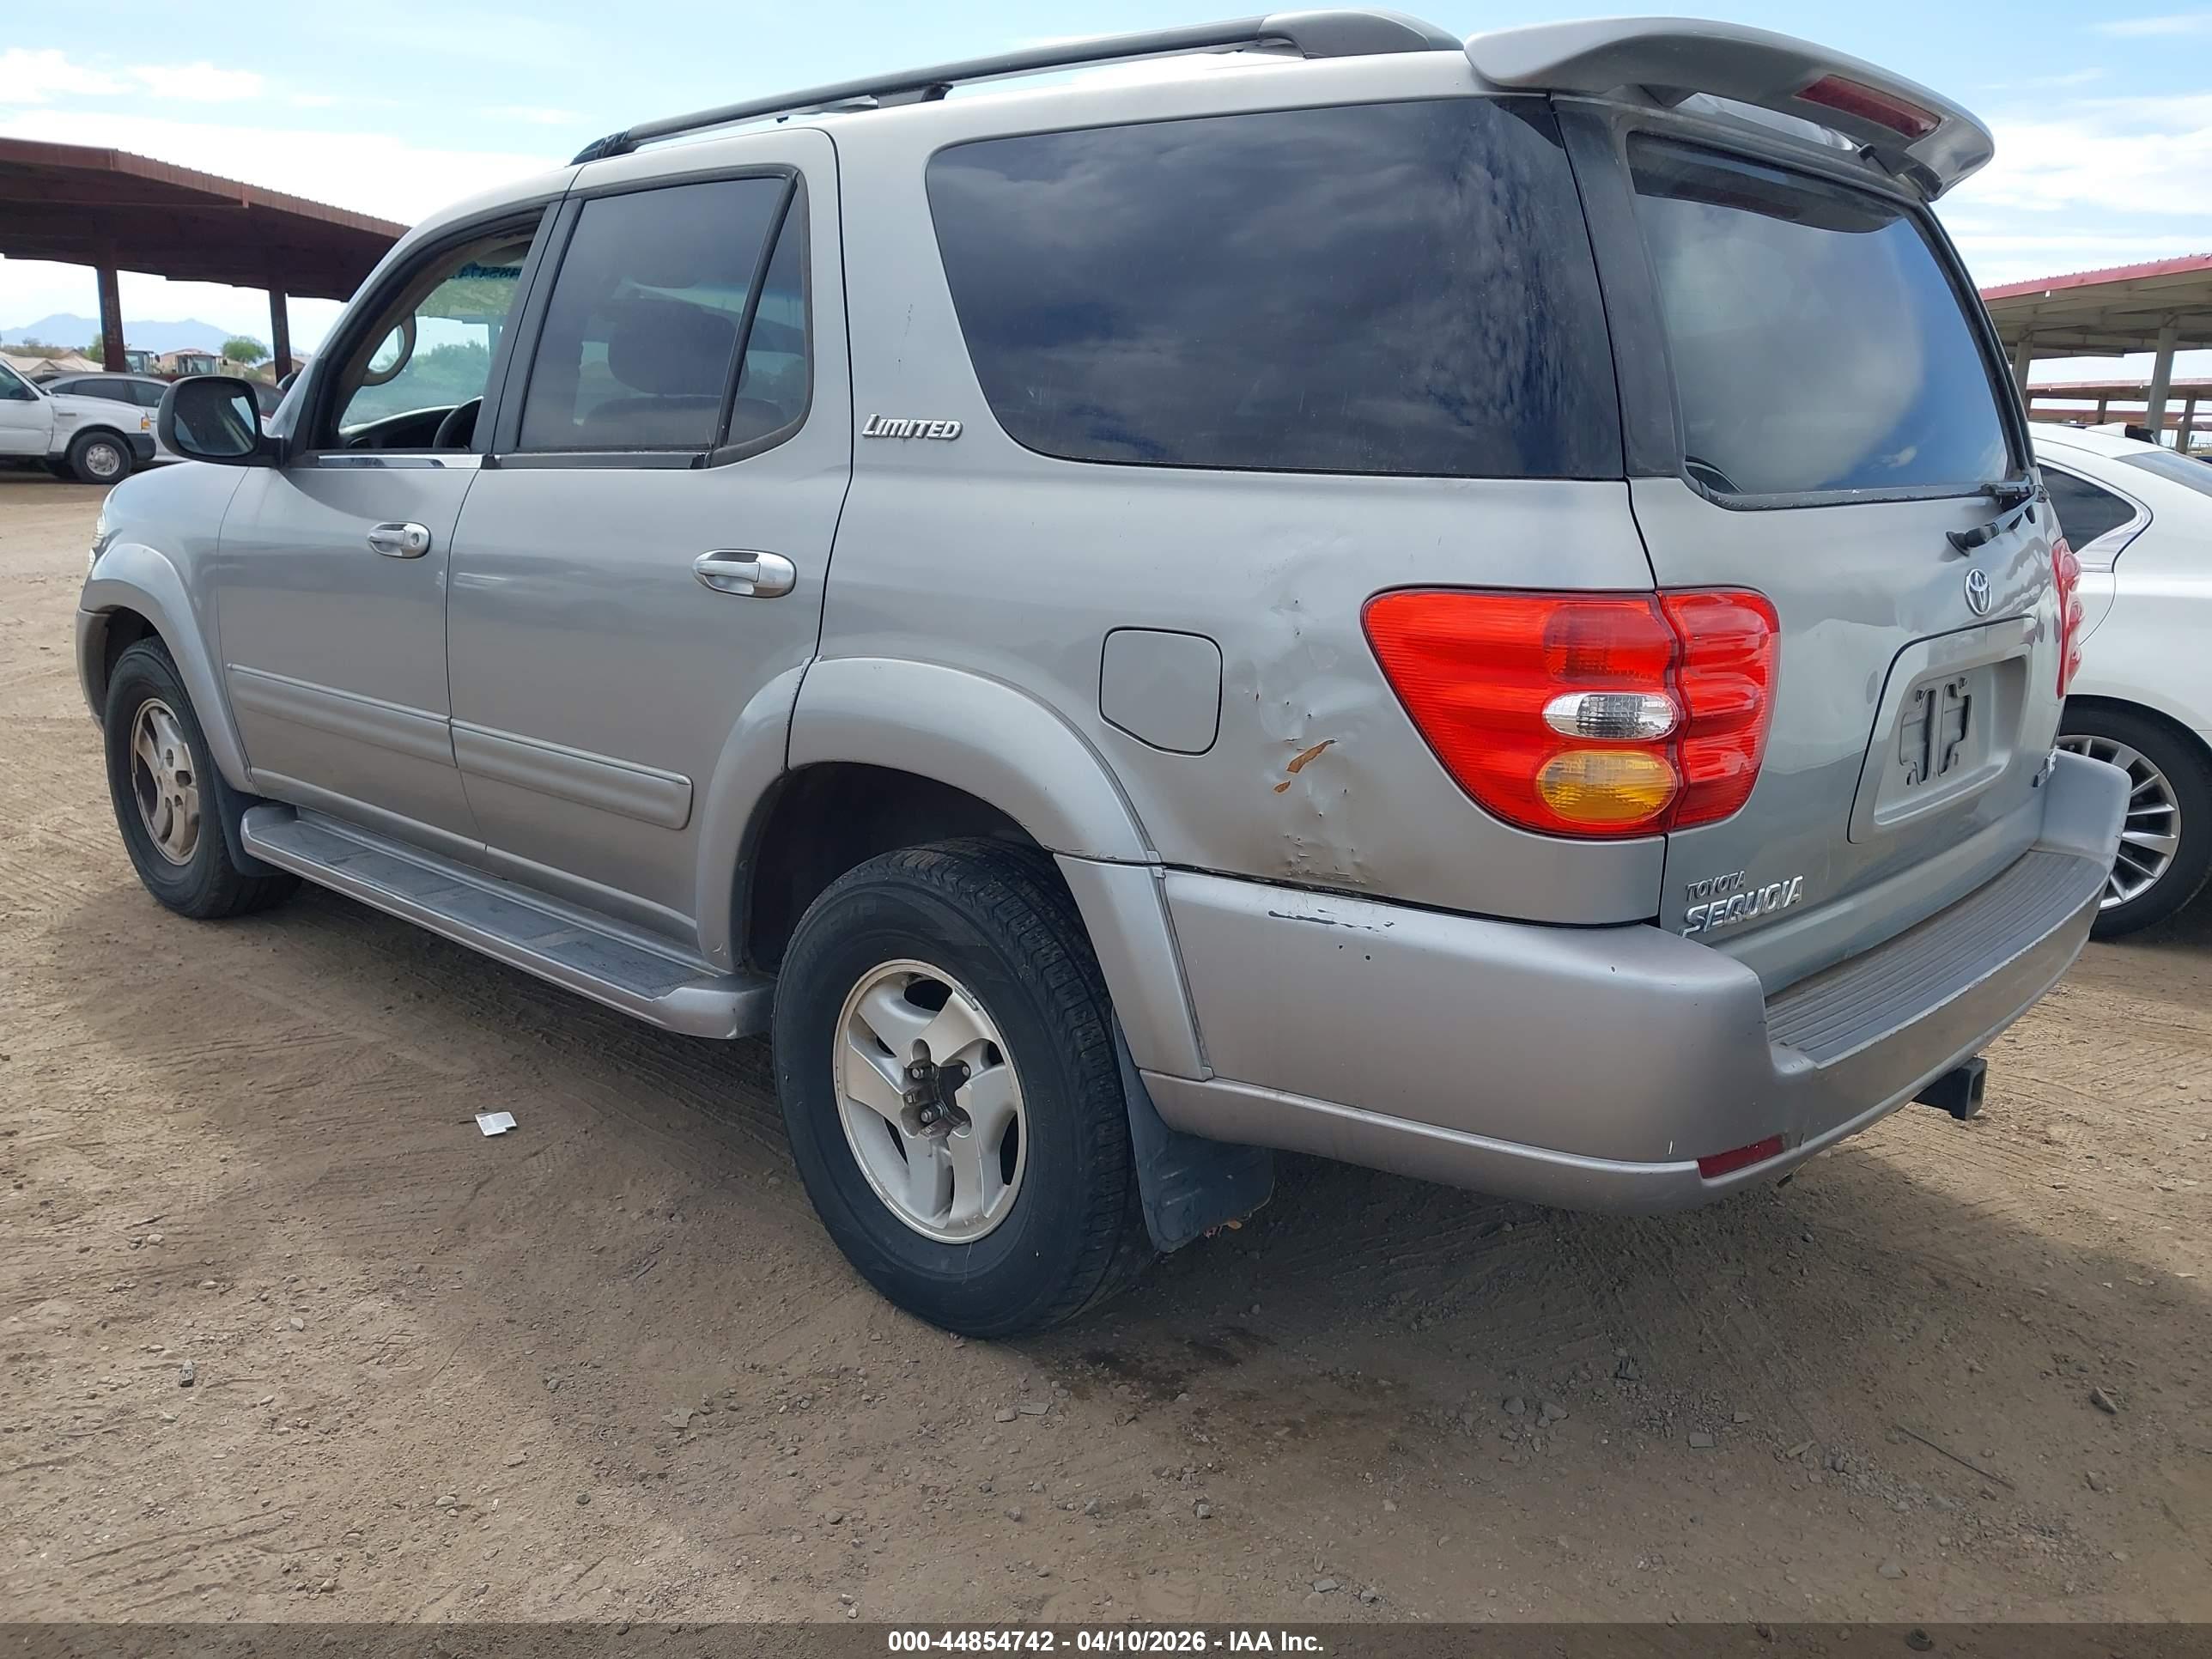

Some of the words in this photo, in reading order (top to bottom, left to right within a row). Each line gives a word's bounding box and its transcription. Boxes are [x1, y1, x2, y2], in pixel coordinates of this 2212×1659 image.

[861, 413, 963, 440] LIMITED
[1686, 870, 1746, 901] TOYOTA
[1678, 874, 1804, 938] SEQUOIA
